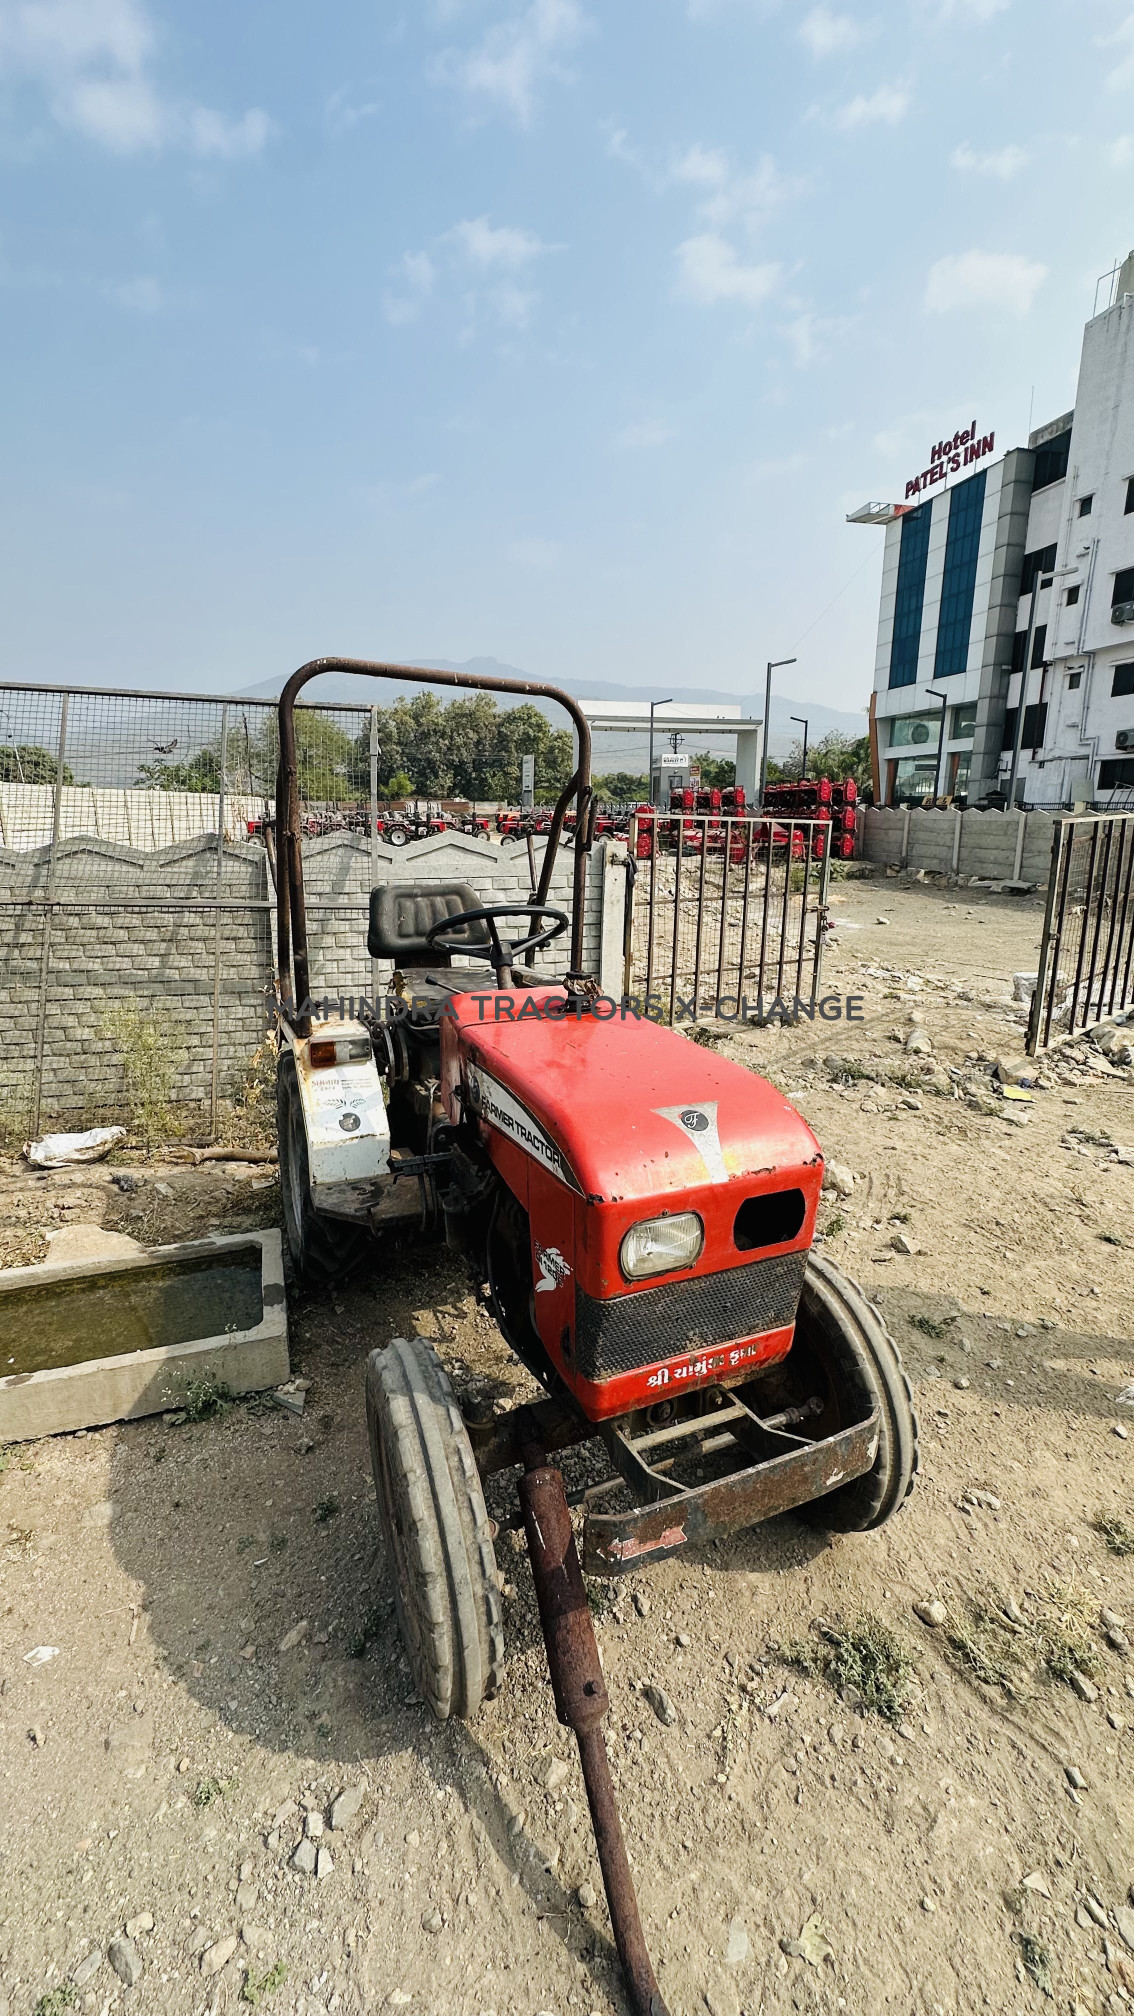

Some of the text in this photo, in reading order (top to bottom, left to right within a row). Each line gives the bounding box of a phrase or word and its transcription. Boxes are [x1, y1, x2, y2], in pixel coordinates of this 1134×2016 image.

[905, 431, 995, 500] PATEL'S INN
[930, 419, 977, 465] Hotel
[514, 1120, 561, 1168] TRACTOR
[646, 1367, 669, 1388] શ્રી
